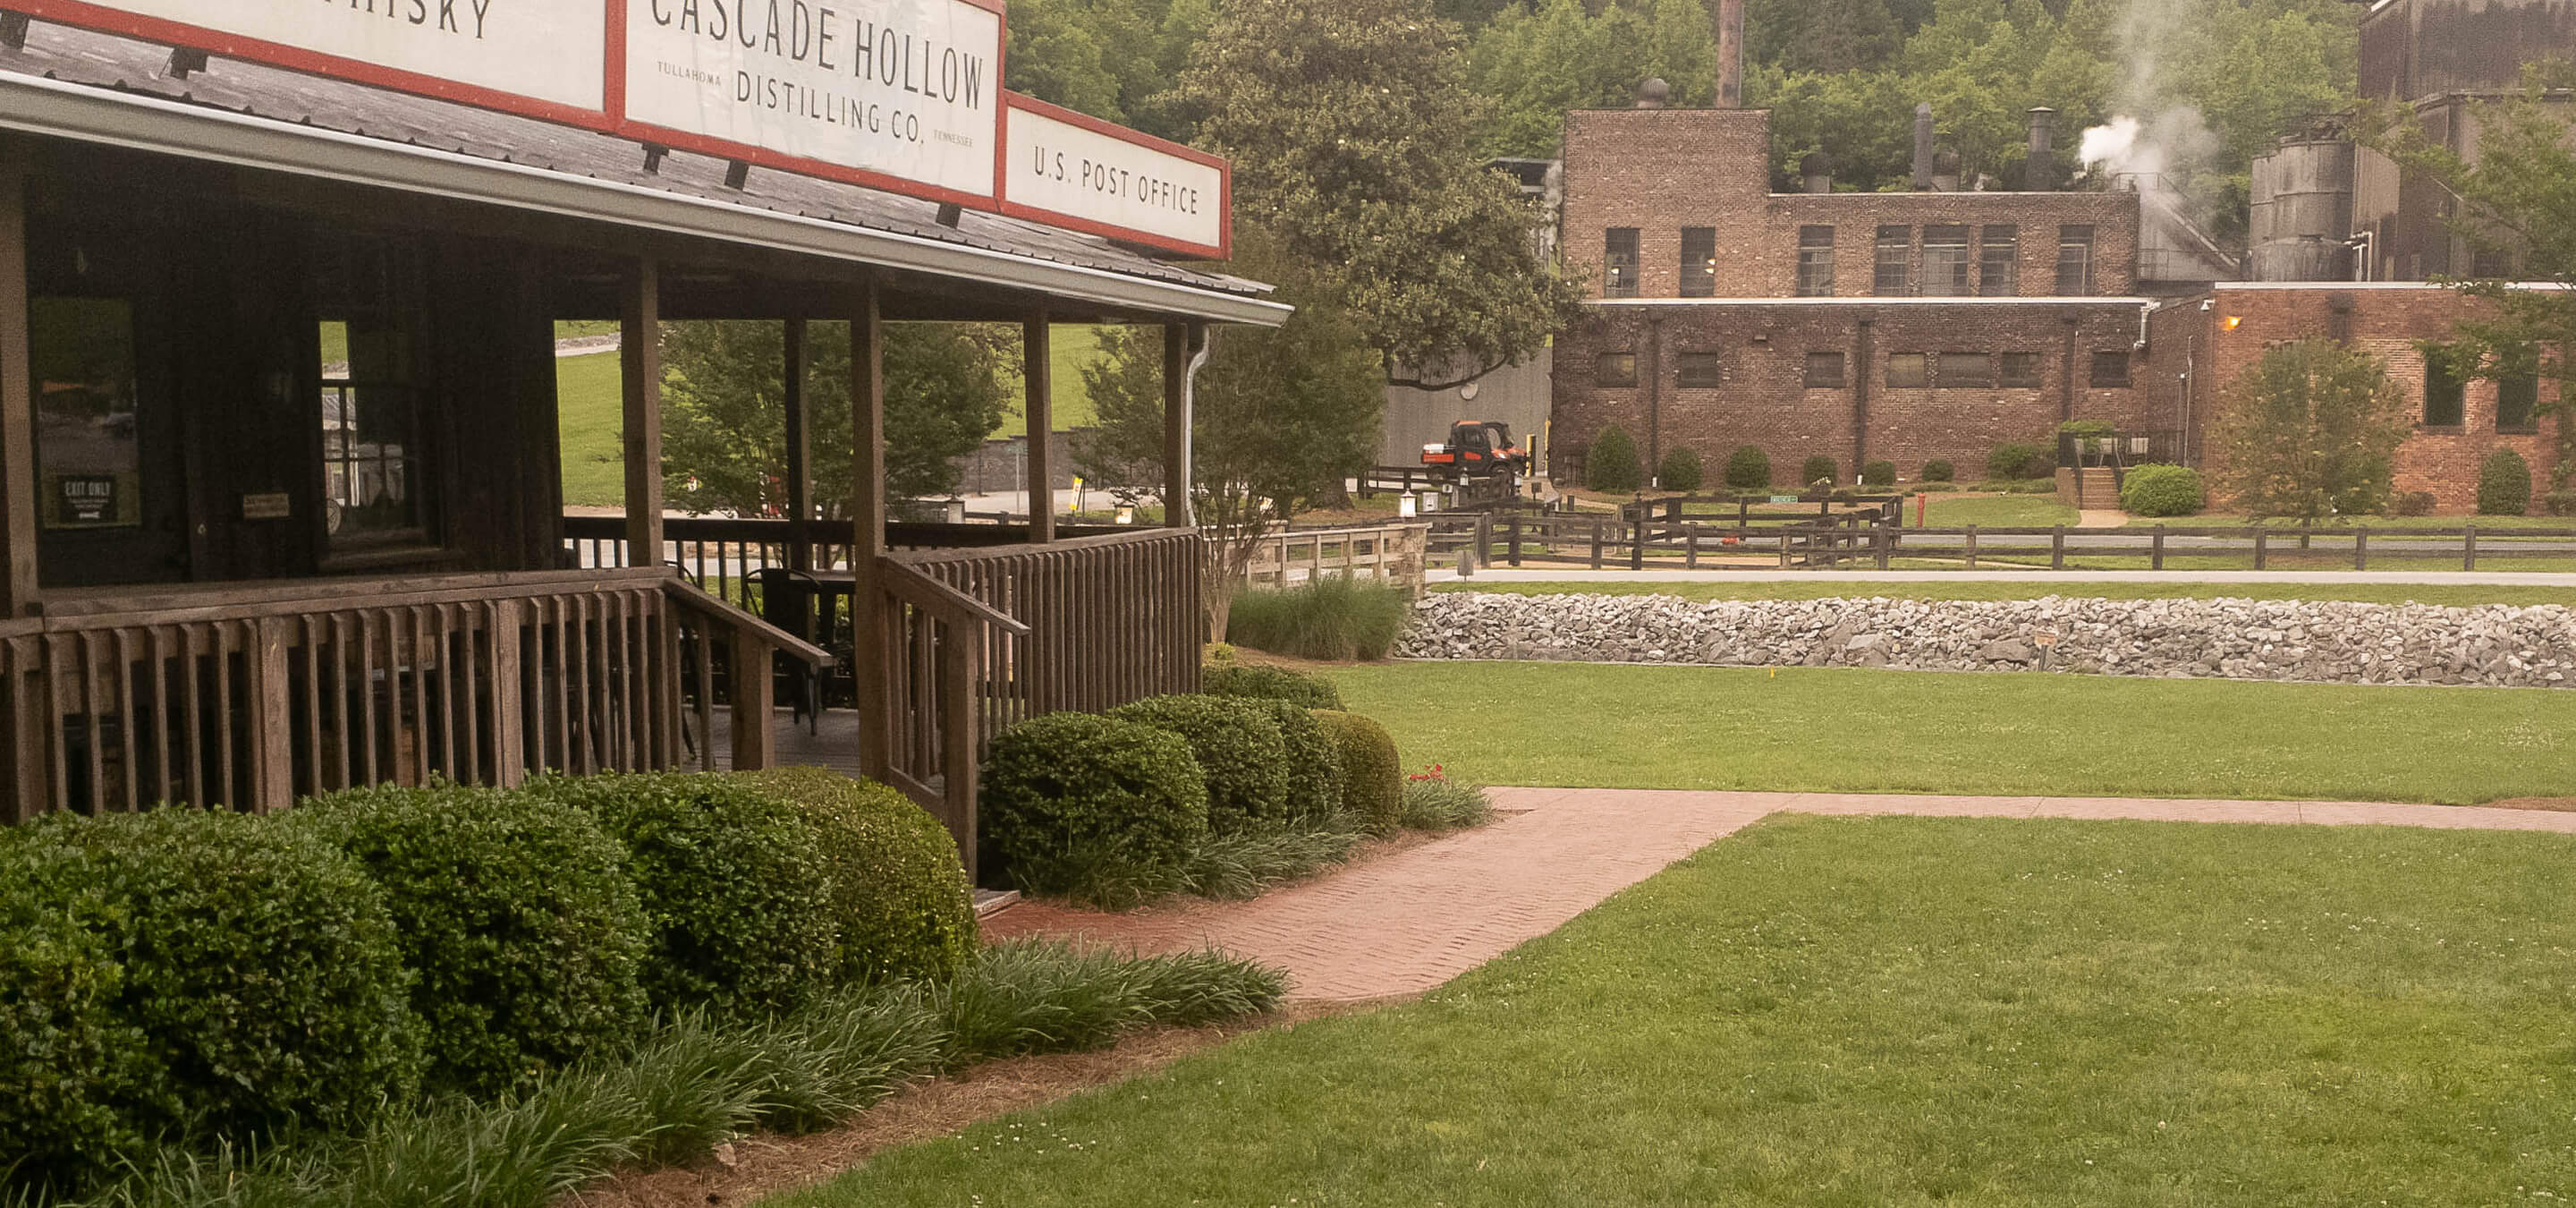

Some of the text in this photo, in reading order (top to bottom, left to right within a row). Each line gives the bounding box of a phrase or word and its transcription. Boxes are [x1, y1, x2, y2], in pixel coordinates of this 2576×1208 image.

[657, 60, 722, 87] TULLAHOMA
[855, 19, 983, 110] HOLLOW
[737, 70, 925, 144] DISTILLING CO.
[933, 129, 973, 148] TENNESSEE
[1035, 146, 1198, 215] U.S. POST OFFICE
[64, 481, 111, 497] EXIT ONLY
